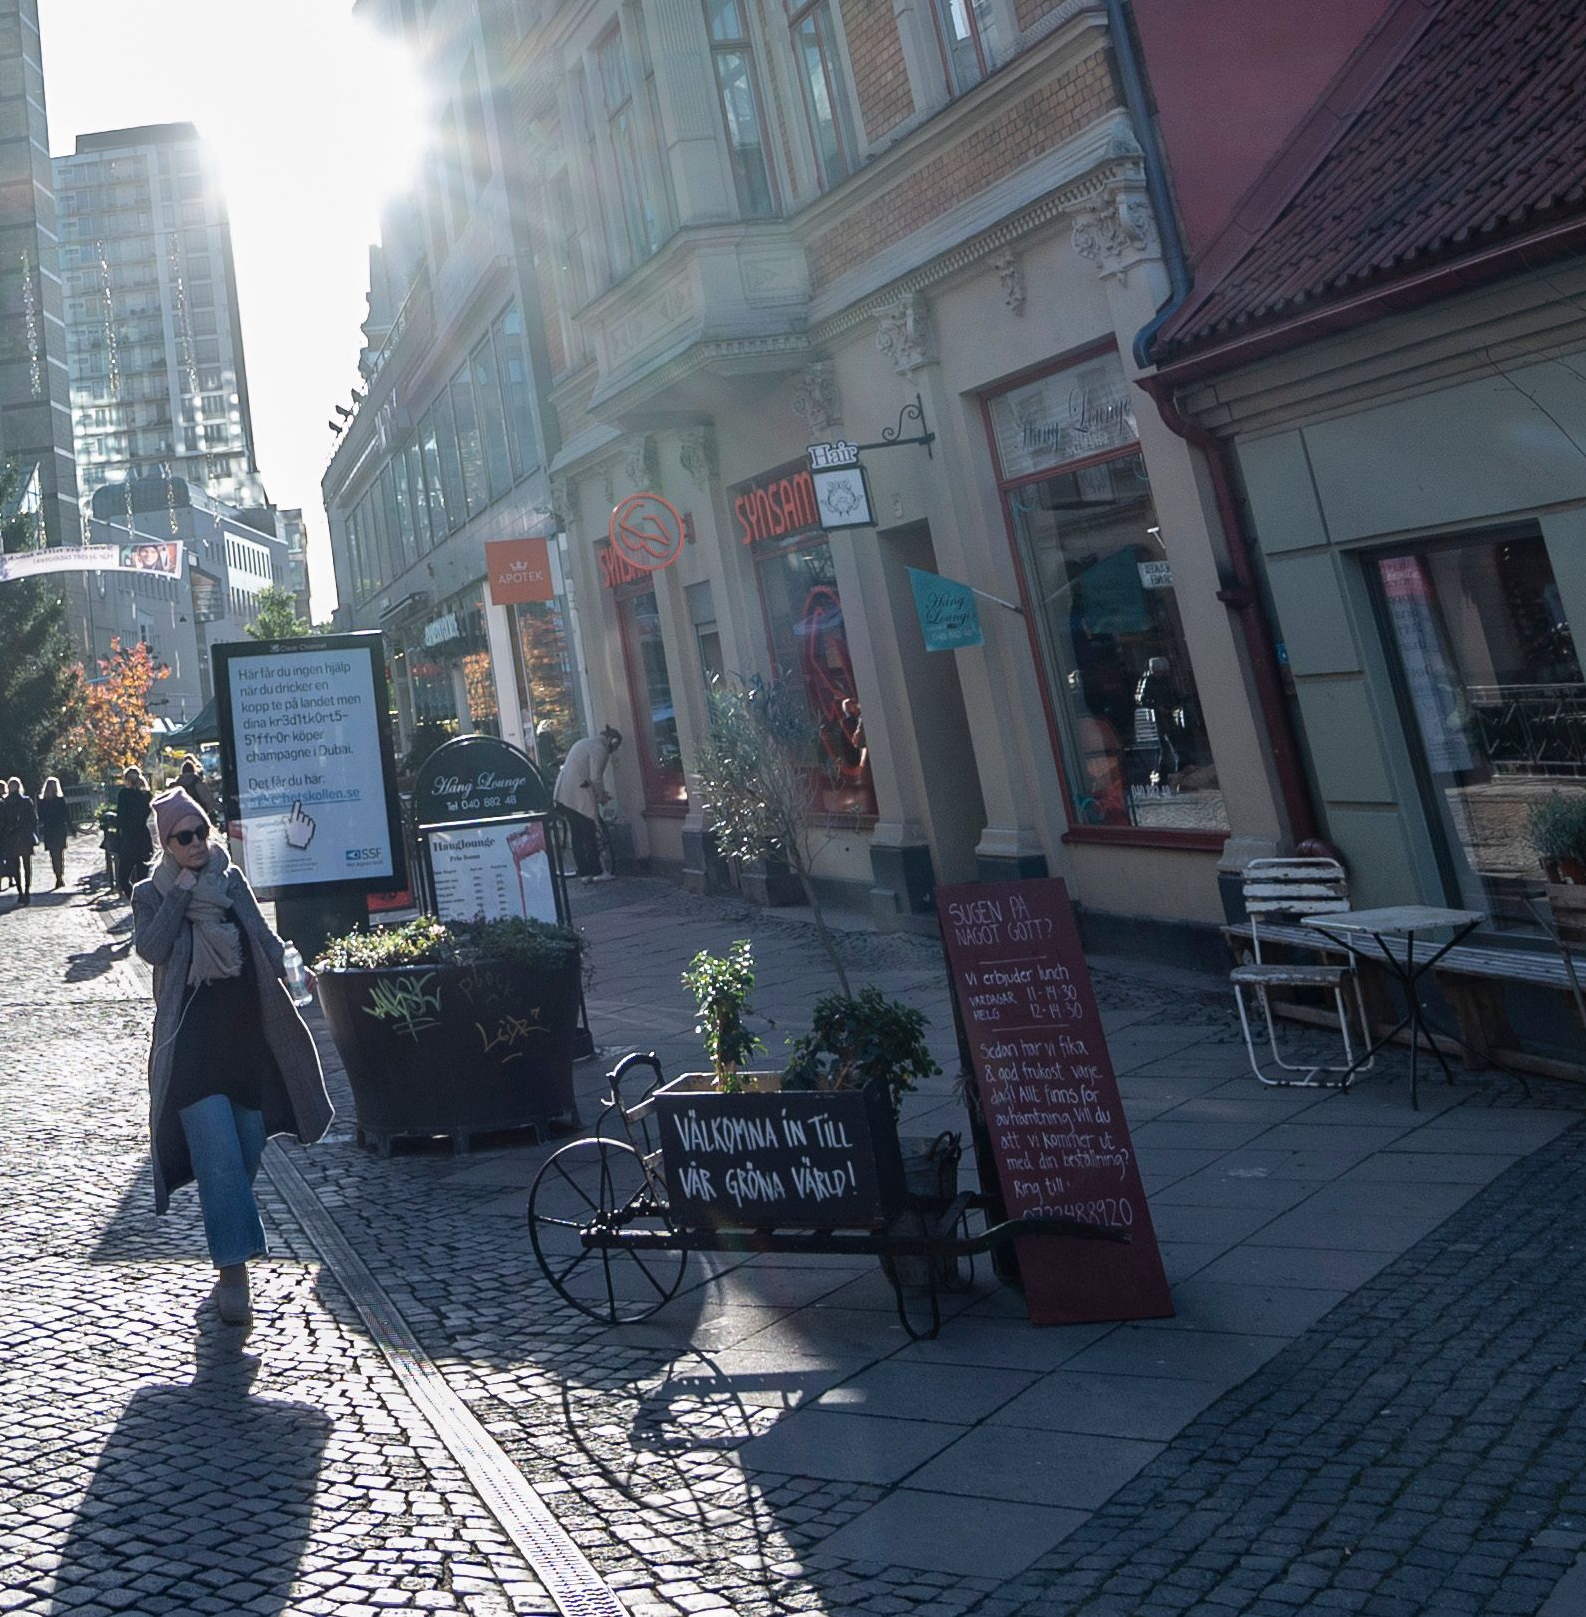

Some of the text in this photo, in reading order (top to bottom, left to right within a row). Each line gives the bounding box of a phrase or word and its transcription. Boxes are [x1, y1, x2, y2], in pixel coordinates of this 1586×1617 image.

[810, 442, 858, 469] Hair
[734, 471, 820, 545] SYNSAM
[498, 571, 544, 584] APOTEK
[238, 662, 351, 681] Här får du ingen hjälp
[240, 681, 329, 697] när du dricker en
[241, 695, 362, 715] kopp te på landet men
[243, 717, 267, 731] dina
[292, 729, 326, 745] köper
[246, 746, 312, 763] champagne
[318, 743, 354, 758] Dubai.
[248, 776, 269, 790] Det
[270, 775, 287, 788] får
[288, 774, 303, 787] du
[475, 771, 527, 793] Lounge
[446, 800, 459, 812] Tel
[461, 799, 481, 809] 040
[483, 797, 502, 807] 882
[362, 847, 382, 860] SSF
[948, 900, 1003, 926] SUGEN
[1007, 918, 1053, 941] GOTT?
[965, 963, 1069, 987] Vi erbjuder lunch
[969, 990, 1017, 1007] VARDAGAR
[973, 1007, 1000, 1022] HELG
[980, 1035, 1089, 1060] Sedan har vi fika
[984, 1061, 1104, 1089] & god frukost varje
[1019, 1085, 1042, 1104] Allt
[1044, 1084, 1079, 1106] finns
[1075, 1106, 1094, 1121] Vill
[1095, 1106, 1112, 1124] du
[673, 1108, 779, 1155] VÄLKOMNA
[807, 1112, 853, 1148] TILL
[1000, 1131, 1116, 1150] att vi kommer ut
[1006, 1151, 1035, 1171] med
[1039, 1152, 1058, 1170] din
[678, 1155, 858, 1208] VÅR GRÖNA VÄRLD!
[1014, 1179, 1043, 1204] Ring
